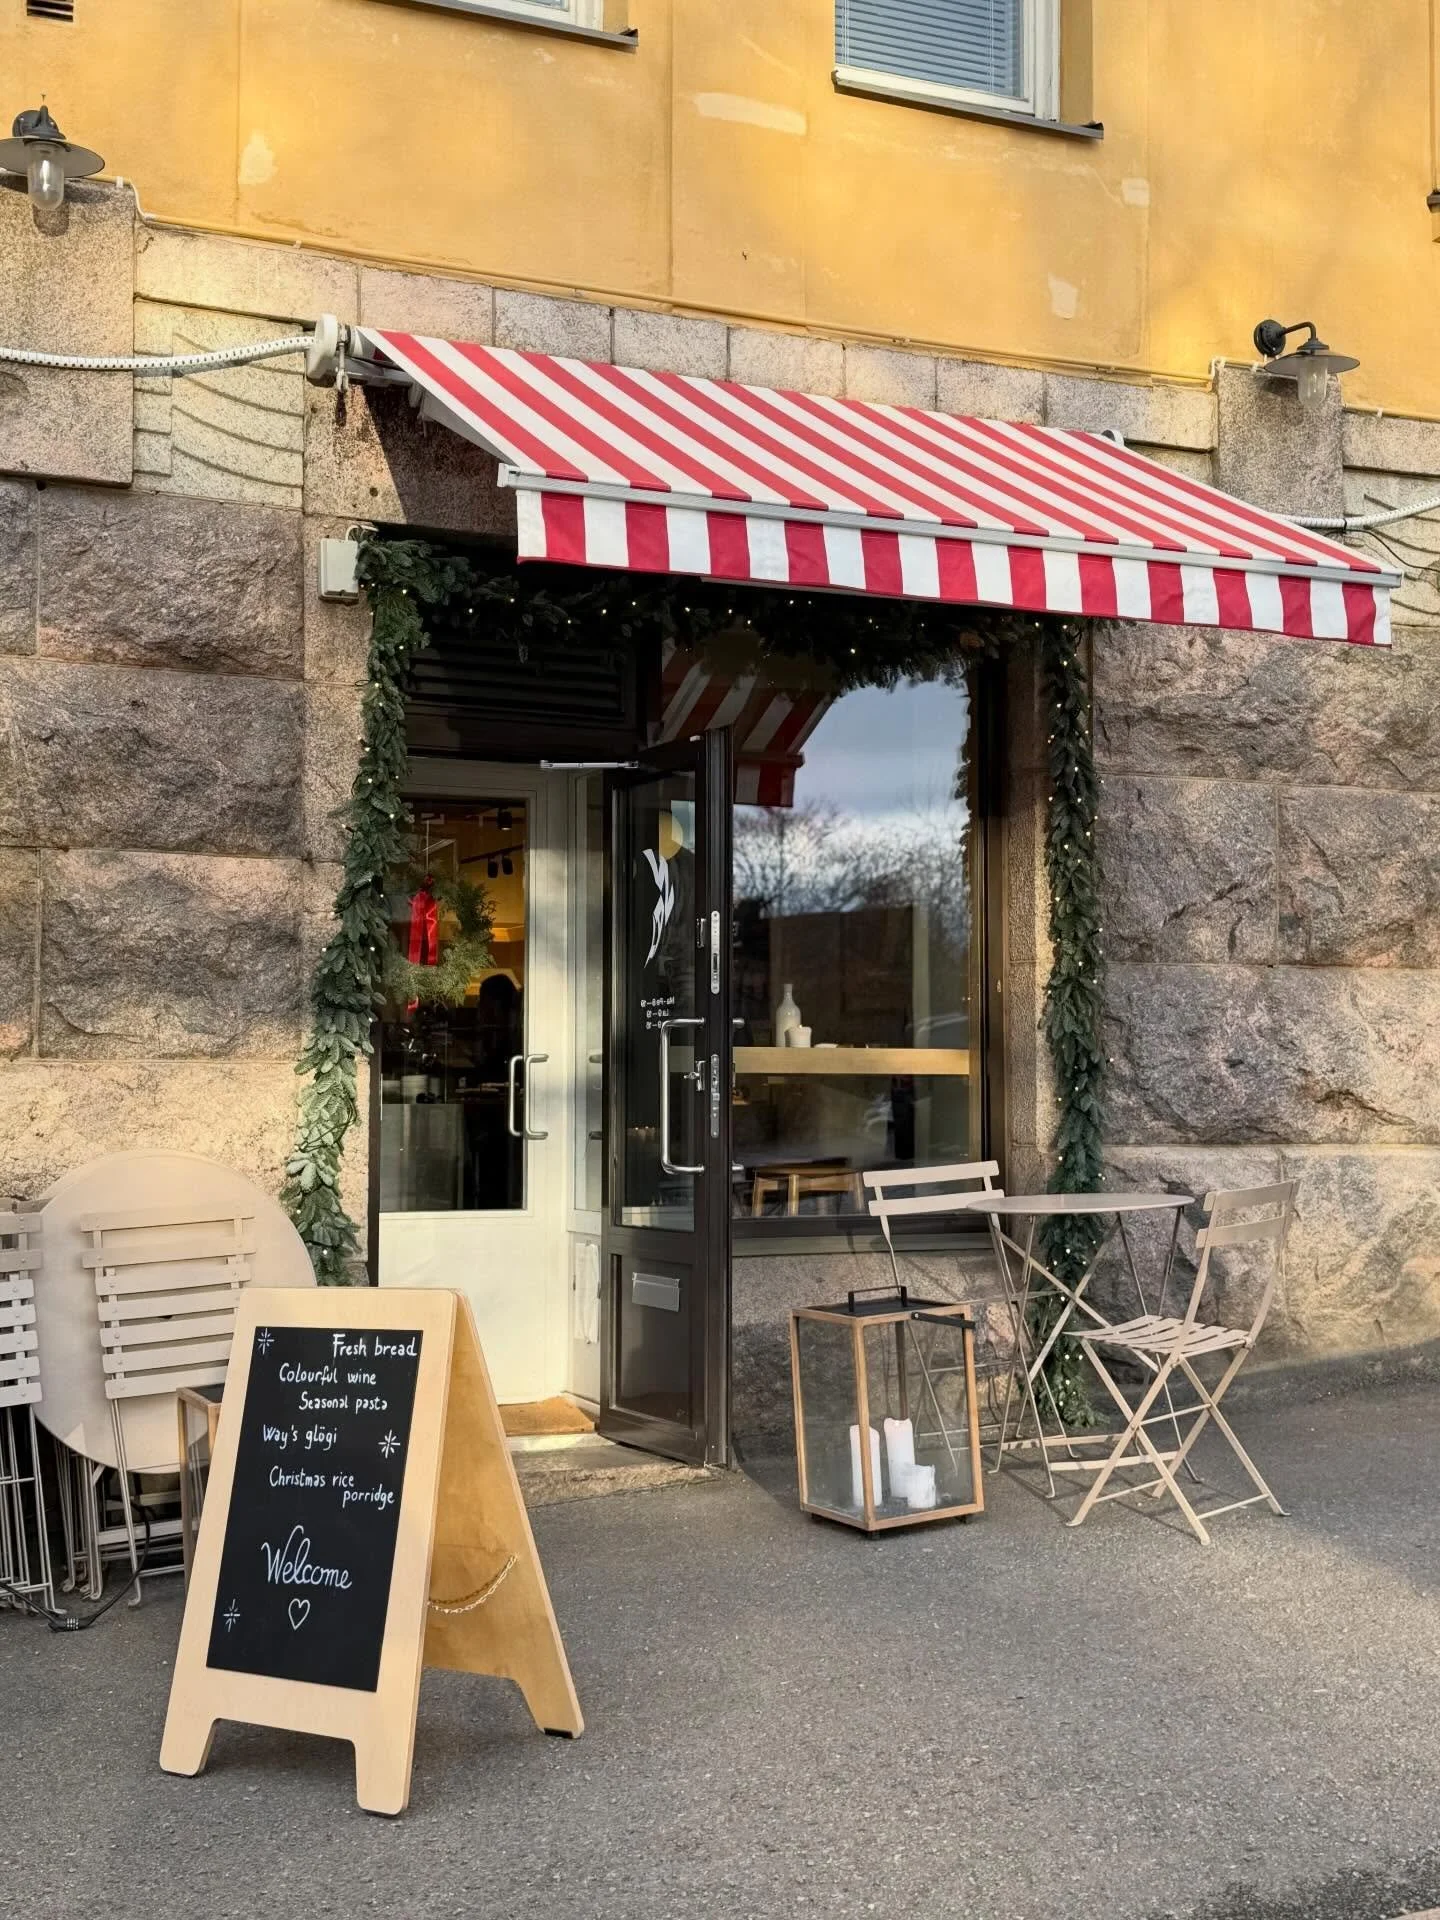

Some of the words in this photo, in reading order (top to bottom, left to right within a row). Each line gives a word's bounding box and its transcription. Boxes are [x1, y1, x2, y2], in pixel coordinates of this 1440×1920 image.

[332, 1333, 367, 1359] Fresh
[374, 1334, 418, 1358] bread
[279, 1362, 339, 1386] Colourful
[347, 1370, 377, 1386] wine
[298, 1391, 349, 1411] Seasonal
[355, 1395, 388, 1415] pasta
[262, 1423, 299, 1452] Way's
[304, 1425, 338, 1452] glögi
[269, 1465, 326, 1488] Christmas
[332, 1474, 355, 1488] rice
[342, 1483, 395, 1511] porridge
[260, 1524, 353, 1590] Welcome
